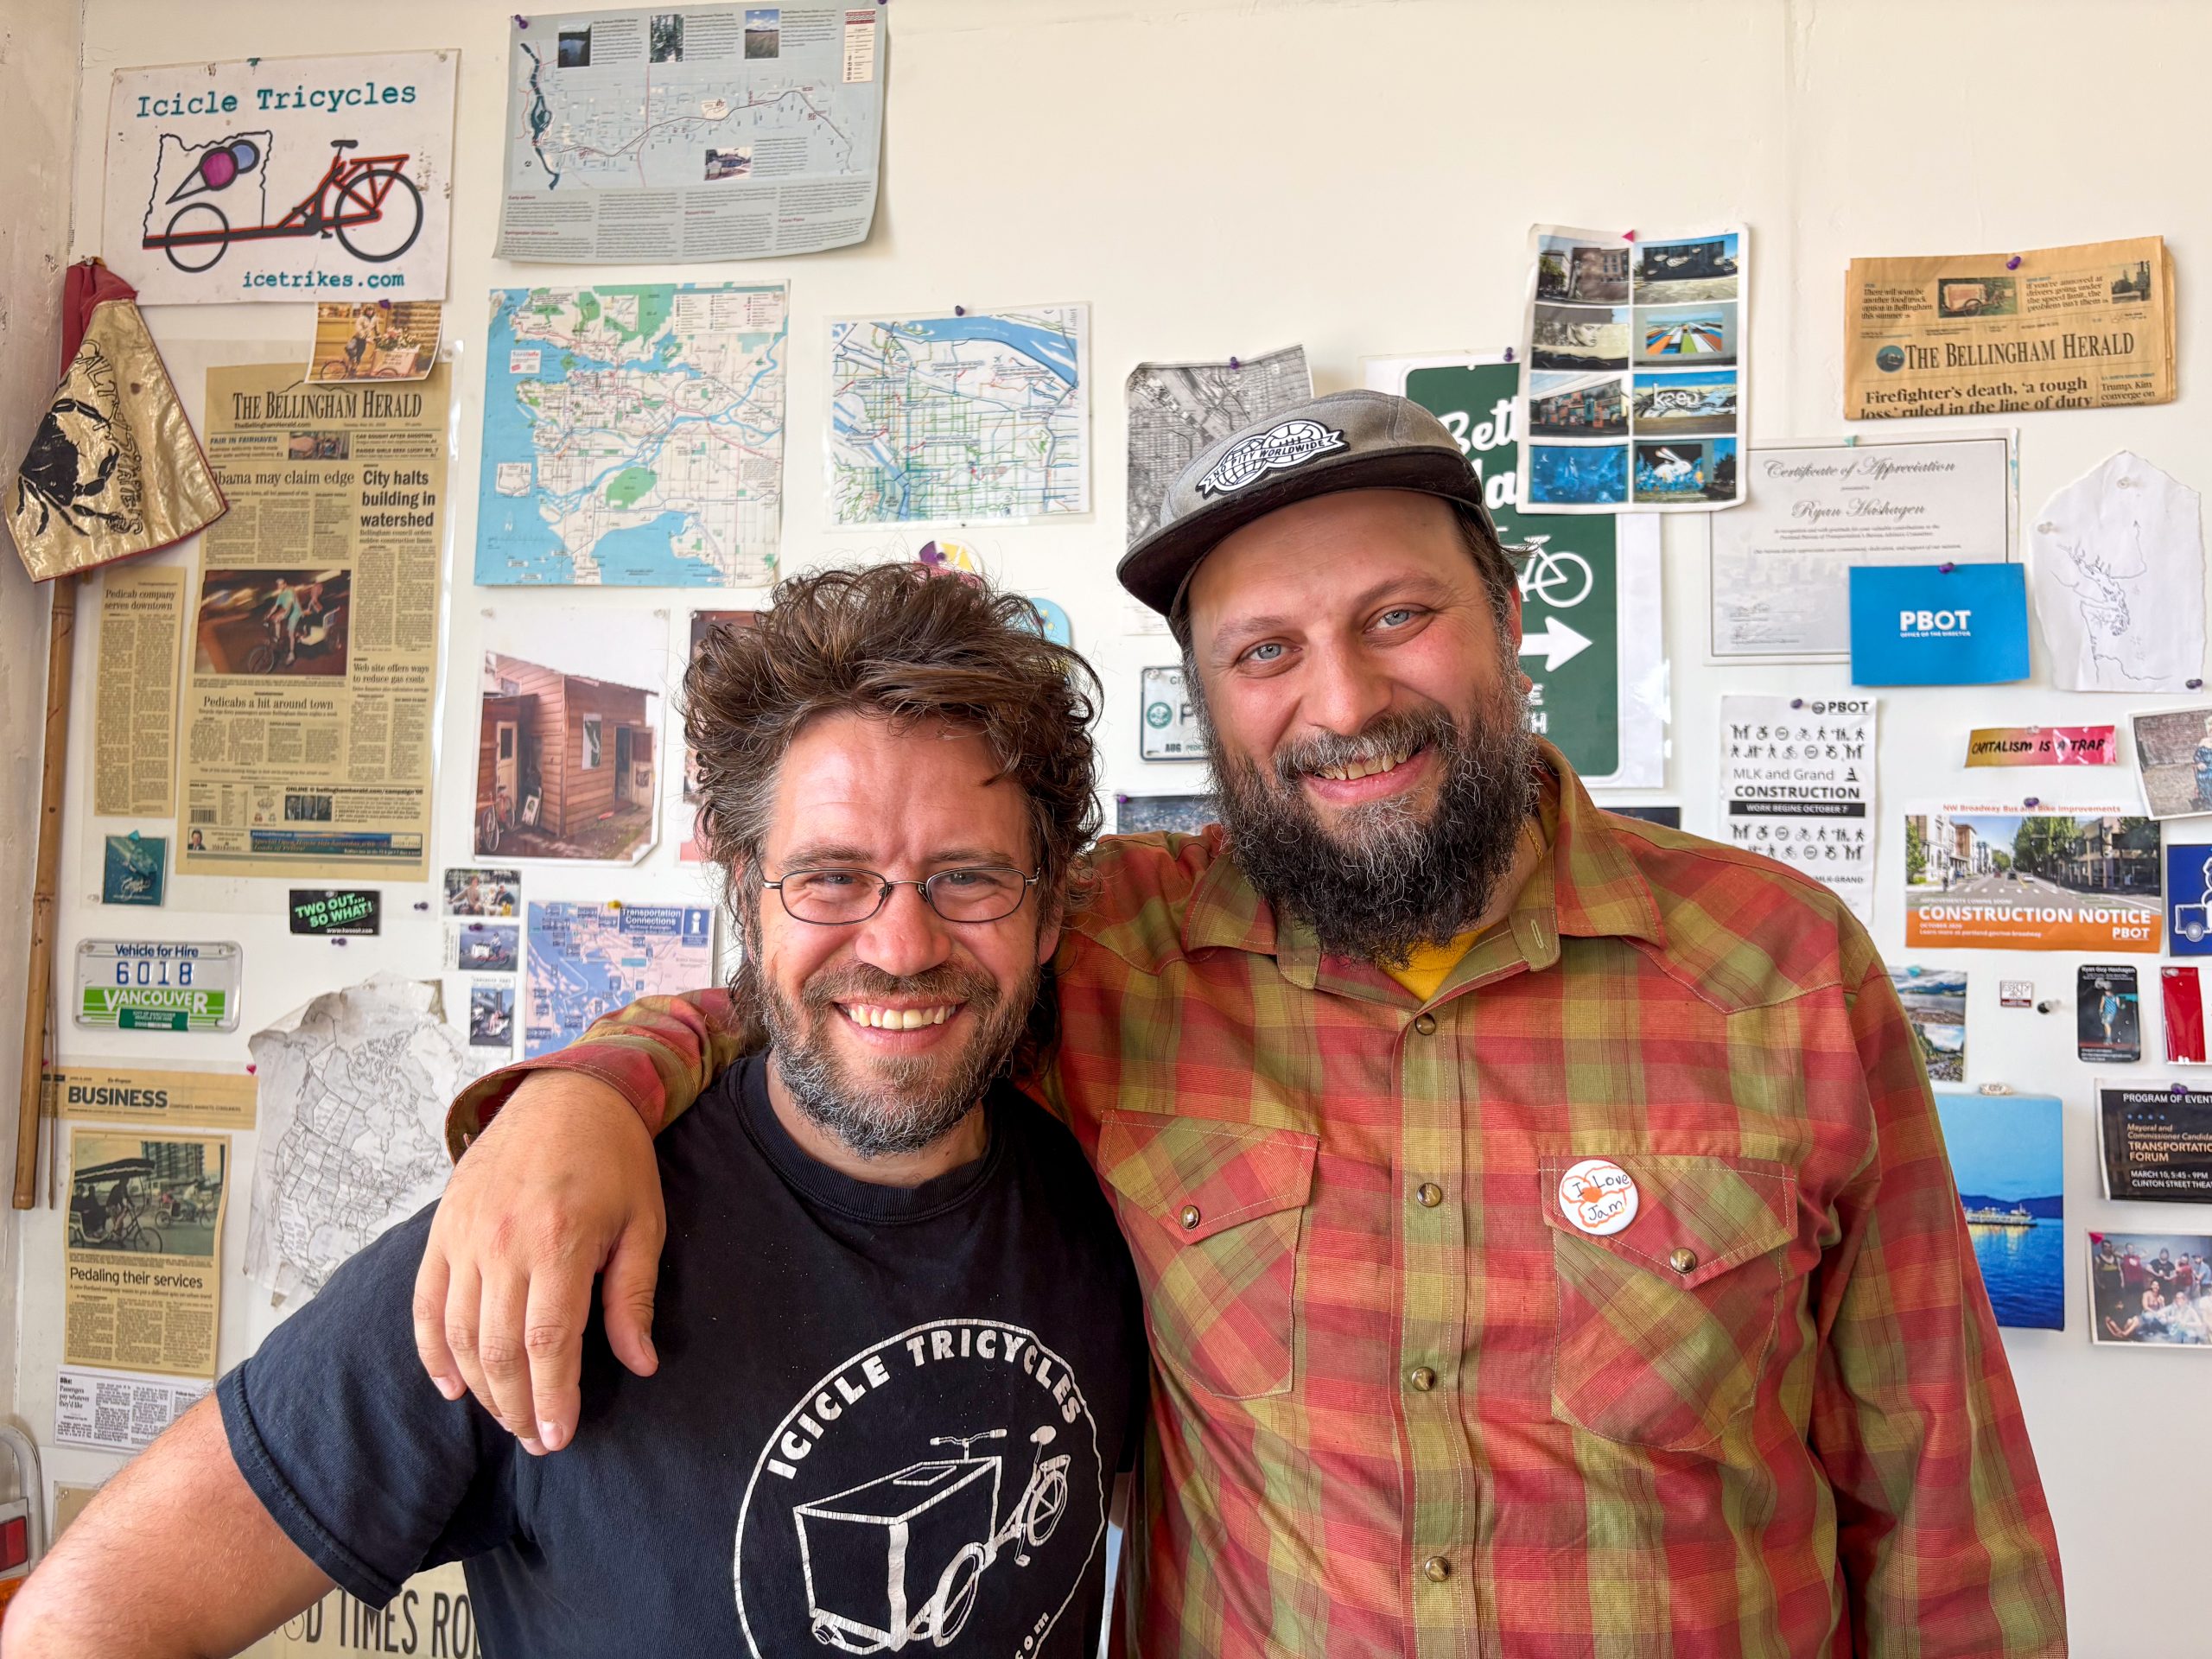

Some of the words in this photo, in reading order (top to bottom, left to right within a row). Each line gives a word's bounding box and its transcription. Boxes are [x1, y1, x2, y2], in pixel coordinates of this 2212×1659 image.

[136, 91, 239, 119] Icicle
[257, 83, 417, 112] Tricycles
[242, 270, 405, 289] icetrikes.com
[1904, 345, 1940, 369] THE
[1945, 338, 2056, 368] BELLINGHAM
[2062, 332, 2134, 359] HERALD
[1866, 386, 1963, 405] Firefighter's
[1966, 382, 2018, 398] death,
[2039, 377, 2088, 394] tough
[232, 392, 262, 420] THE
[266, 391, 358, 420] BELLINGHAM
[363, 389, 423, 419] HERALD
[1901, 403, 1944, 419] ruled
[1948, 402, 1964, 416] in
[1968, 399, 1996, 415] the
[1999, 397, 2031, 413] line
[2034, 395, 2053, 410] of
[2056, 394, 2094, 410] duty
[1213, 465, 1227, 479] NO
[1230, 451, 1256, 467] PITY
[1258, 439, 1325, 458] WORLDWIDE
[1763, 460, 1839, 483] Certificate
[1858, 456, 1956, 481] Appreciation
[256, 473, 281, 489] may
[284, 469, 321, 486] claim
[324, 470, 354, 489] edge
[363, 470, 390, 490] City
[393, 469, 429, 486] halts
[361, 491, 419, 509] building
[423, 490, 435, 506] in
[360, 512, 434, 528] watershed
[1791, 499, 1842, 525] Ryan
[105, 588, 137, 599] Pedicab
[138, 591, 176, 601] company
[130, 601, 173, 610] downtown
[1899, 609, 1972, 632] PBOT
[353, 663, 370, 672] Web
[371, 664, 386, 672] site
[363, 674, 390, 683] reduce
[203, 696, 246, 709] Pedicabs
[257, 697, 271, 708] hit
[273, 697, 308, 709] around
[309, 699, 334, 710] town
[1827, 701, 1870, 714] PBOT
[1164, 743, 1181, 753] AUG
[2039, 741, 2050, 753] IS
[2057, 741, 2067, 751] A
[2069, 738, 2105, 752] TRAP
[1733, 767, 1762, 780] MLK
[1765, 767, 1789, 780] and
[1796, 767, 1834, 781] Grand
[1734, 785, 1860, 799] CONSTRUCTION
[1771, 804, 1802, 813] BEGINS
[1802, 804, 1841, 813] OCTOBER
[1960, 804, 2000, 814] Broadway
[2058, 804, 2120, 814] Improvements
[295, 900, 327, 919] TWO
[309, 912, 328, 928] SO
[330, 900, 373, 923] WHAT!
[622, 909, 681, 918] Transportation
[1918, 906, 2073, 924] CONSTRUCTION
[2078, 907, 2152, 925] NOTICE
[625, 916, 677, 926] Connections
[2111, 926, 2151, 940] PBOT
[115, 944, 155, 957] Vehicle
[156, 944, 173, 957] for
[175, 945, 200, 958] Hire
[116, 960, 193, 987] 6018
[103, 988, 209, 1014] VANCOUVER
[67, 1085, 168, 1109] BUSINESS
[2122, 1093, 2168, 1103] PROGRAM
[2170, 1094, 2183, 1103] OF
[2184, 1095, 2212, 1104] EVENT
[2126, 1122, 2158, 1133] Mayoral
[2127, 1131, 2180, 1141] Commissioner
[2181, 1132, 2212, 1141] Candida
[2127, 1141, 2212, 1153] TRANSPORTATIO
[2129, 1152, 2170, 1162] FORUM
[2130, 1170, 2158, 1179] MARCH
[2191, 1172, 2209, 1180] 9PM
[2132, 1179, 2165, 1188] CLINTON
[2164, 1179, 2190, 1188] STREET
[1572, 1181, 1585, 1198] I
[1592, 1173, 1630, 1190] Love
[1587, 1199, 1624, 1222] Jam
[69, 1267, 120, 1287] Pedaling
[123, 1269, 151, 1286] their
[154, 1273, 204, 1290] services
[767, 1354, 891, 1479] ICICLE
[906, 1327, 1082, 1424] TRICYCLES
[336, 1586, 419, 1656] TIMES
[432, 1591, 482, 1659] RO
